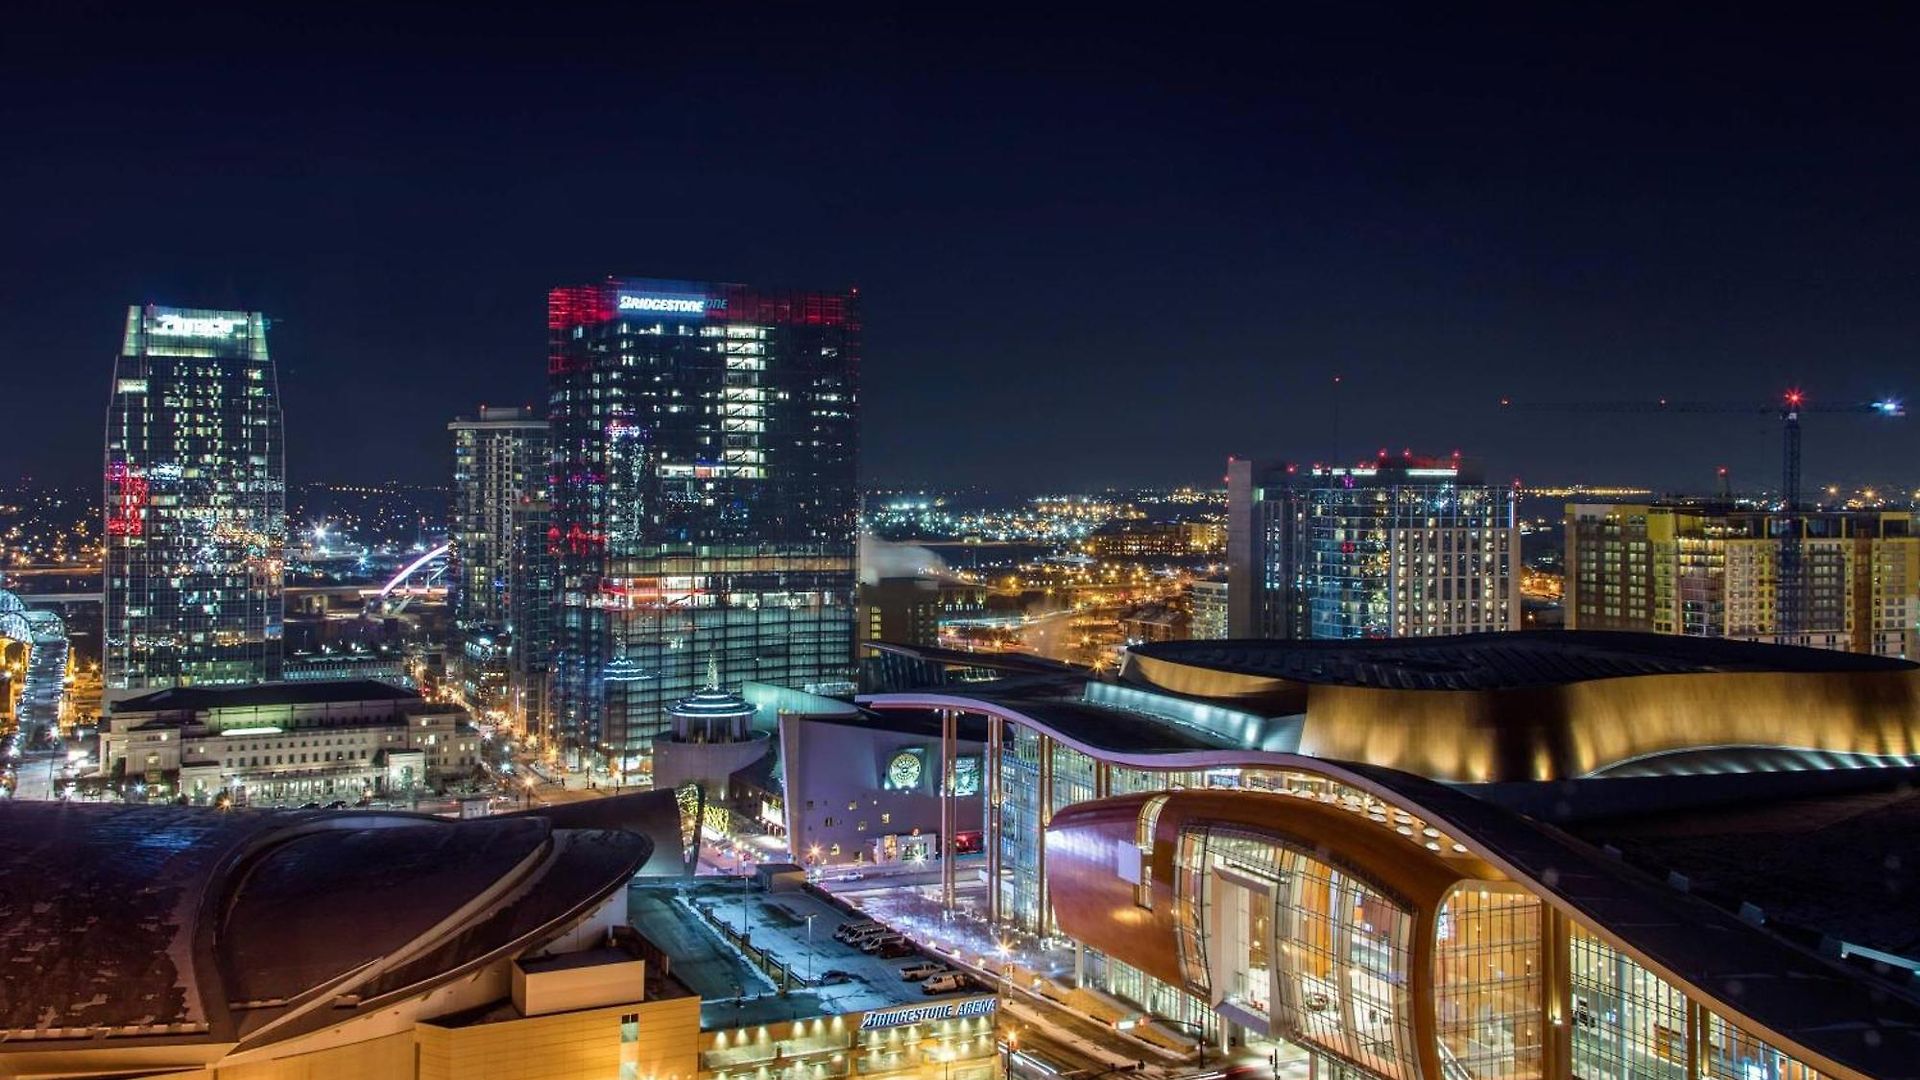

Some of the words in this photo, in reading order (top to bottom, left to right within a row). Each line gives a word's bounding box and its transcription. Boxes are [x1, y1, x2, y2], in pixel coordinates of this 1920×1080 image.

[619, 296, 704, 312] BRIDGESTONE
[860, 1005, 953, 1028] BRIDGESTONE
[957, 998, 996, 1015] ARENA
